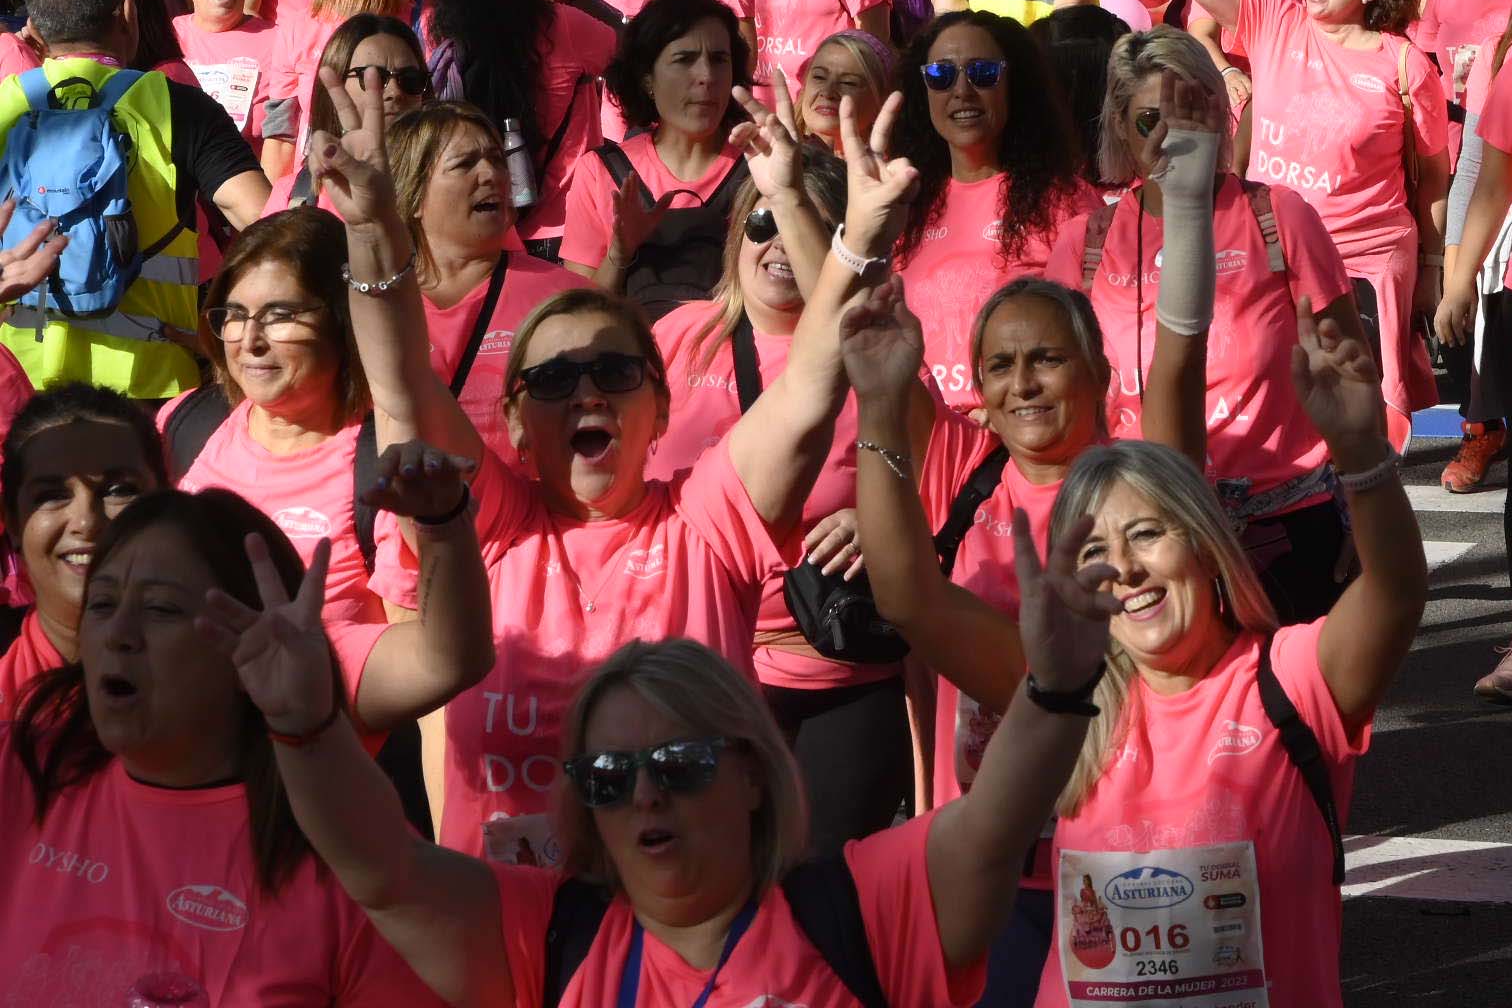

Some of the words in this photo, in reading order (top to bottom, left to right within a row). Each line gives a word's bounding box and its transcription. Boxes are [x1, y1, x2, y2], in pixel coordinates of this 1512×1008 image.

[757, 35, 806, 55] ORSAL
[1260, 117, 1285, 145] TU
[973, 507, 1012, 537] OYSH
[483, 692, 538, 736] TU
[28, 842, 109, 884] OYSHO
[1200, 870, 1241, 882] SUMA
[1111, 884, 1187, 901] ASTURIANA
[172, 894, 242, 927] ASTURIANA
[1119, 923, 1191, 953] 016
[1136, 959, 1179, 977] 2346
[1086, 986, 1136, 998] CARRERA
[1138, 985, 1157, 996] DE
[1158, 984, 1173, 995] LA
[1175, 980, 1216, 992] MUJER
[1220, 976, 1248, 987] 2023
